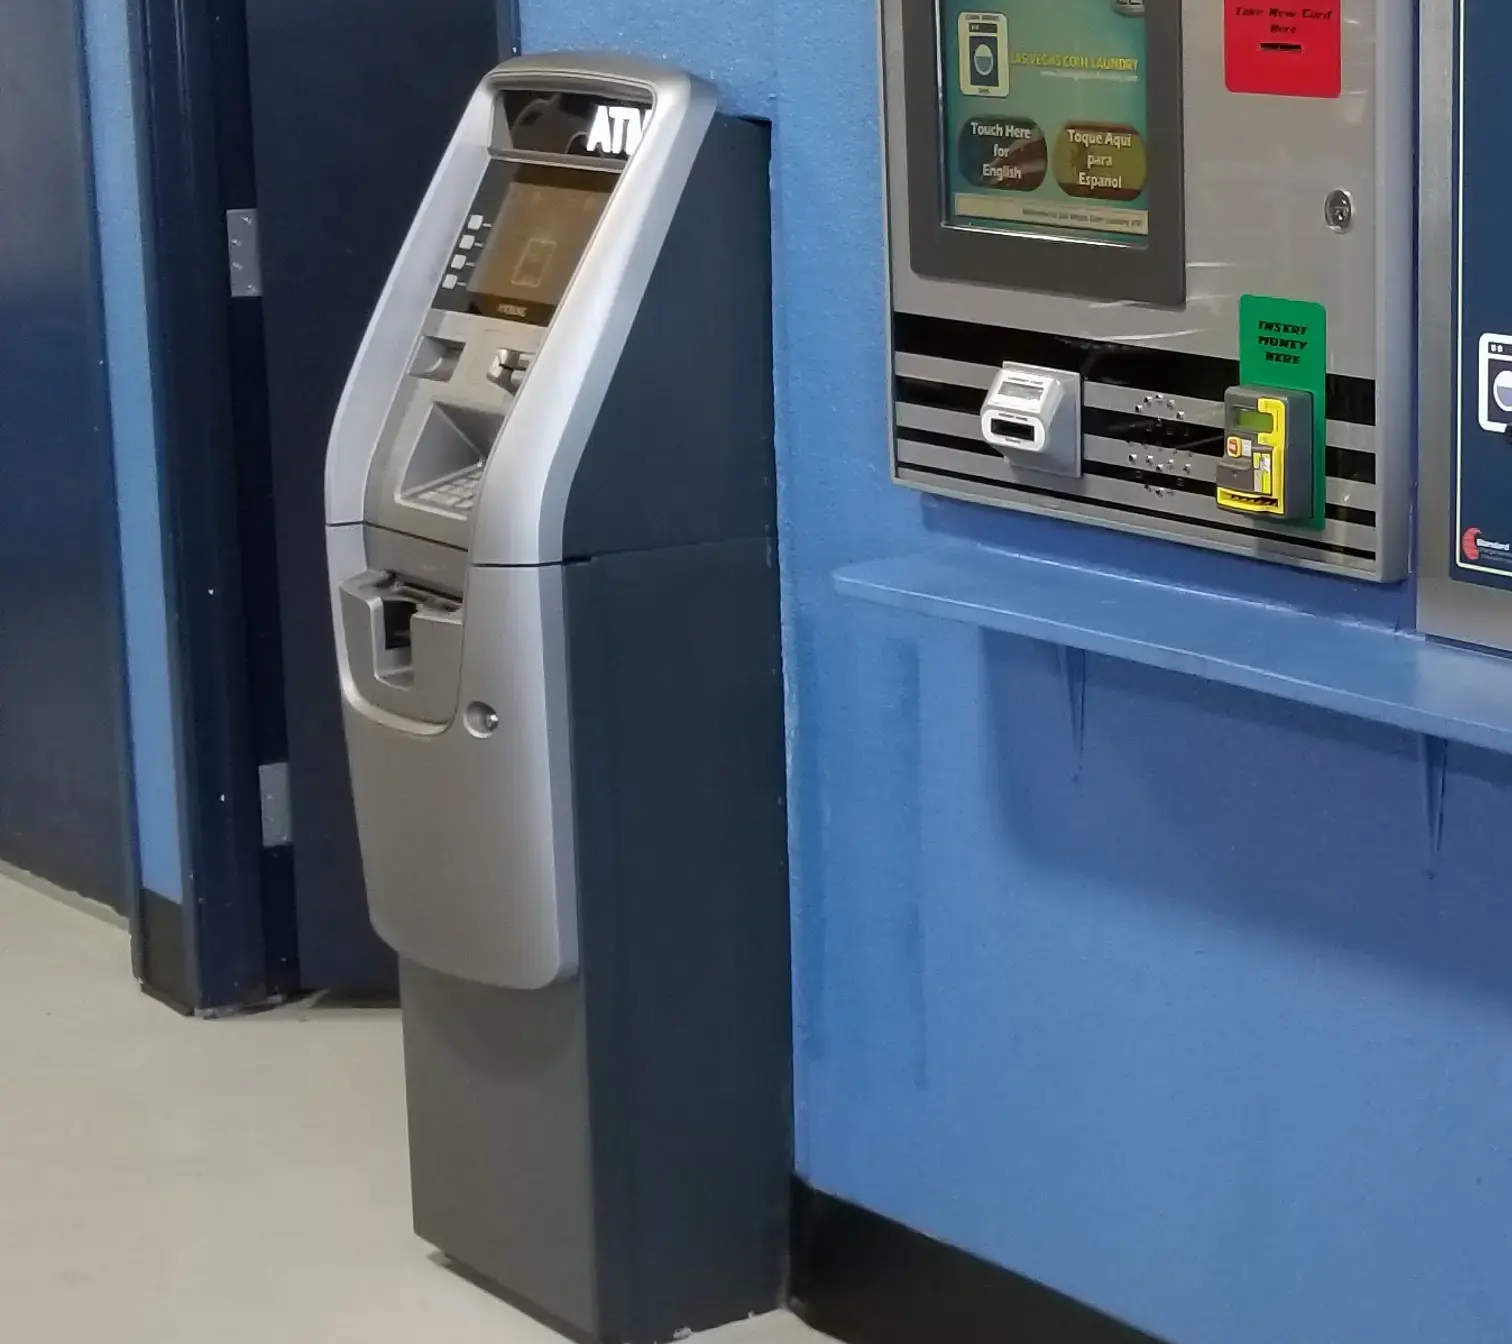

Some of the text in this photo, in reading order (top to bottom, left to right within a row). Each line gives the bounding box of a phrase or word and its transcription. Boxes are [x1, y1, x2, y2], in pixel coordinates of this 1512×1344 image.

[971, 121, 1032, 139] Touch Here
[1067, 129, 1103, 147] Toque
[993, 143, 1010, 158] for
[1087, 153, 1113, 169] para
[982, 163, 1022, 181] English
[1258, 320, 1308, 336] INSERT
[1258, 335, 1309, 350] MONEY
[1264, 350, 1300, 365] HERE
